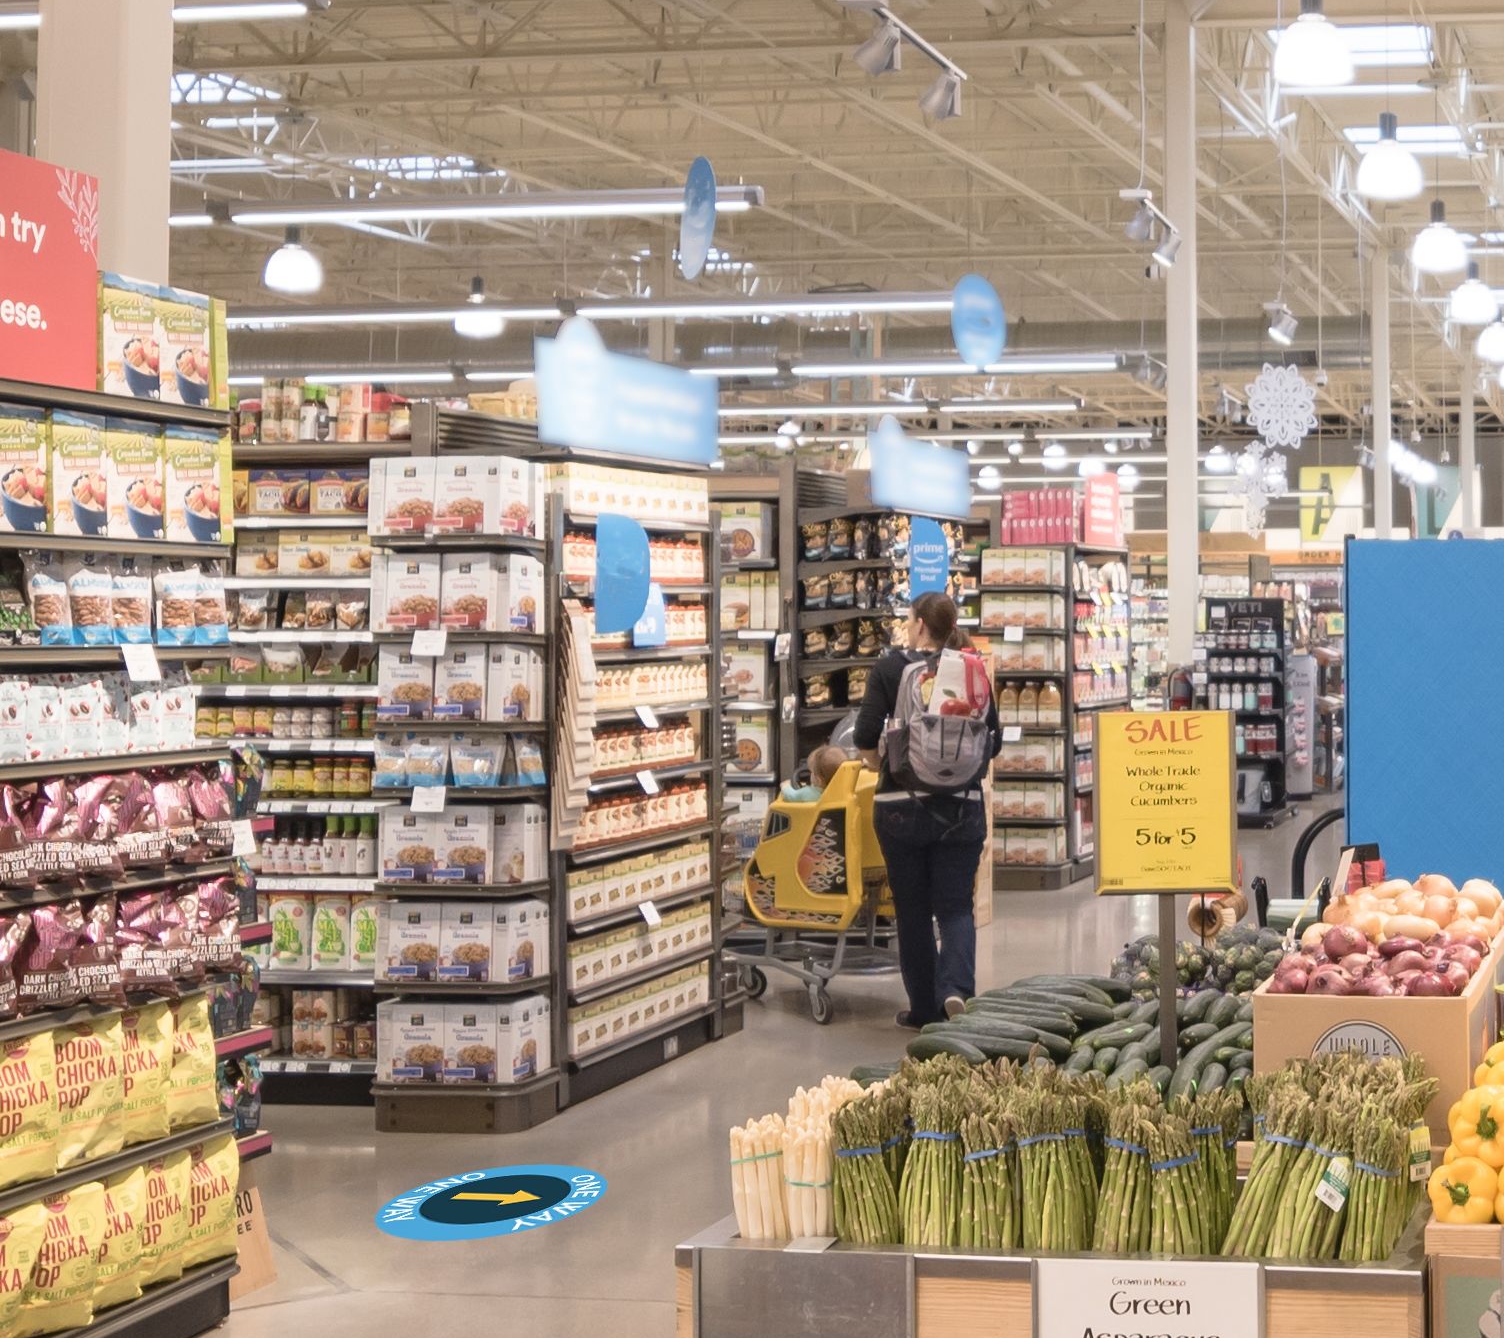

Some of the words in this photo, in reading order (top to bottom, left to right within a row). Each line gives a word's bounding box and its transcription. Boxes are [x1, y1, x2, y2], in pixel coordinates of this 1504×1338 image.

[11, 212, 46, 254] try
[1227, 601, 1263, 613] YETI
[1125, 716, 1203, 743] SALE
[1126, 766, 1163, 777] Whole
[1166, 766, 1200, 776] Trade
[1139, 781, 1188, 794] Organic
[1130, 796, 1198, 806] Cucumbers
[1136, 828, 1151, 846] 5
[1154, 831, 1173, 845] for
[412, 1172, 486, 1195] ONE
[571, 1174, 601, 1198] ONE
[383, 1194, 428, 1224] WAY
[511, 1201, 589, 1231] WAY
[1111, 1276, 1142, 1286] Grown
[1143, 1278, 1152, 1286] in
[1154, 1277, 1186, 1286] Mexico
[1109, 1291, 1191, 1315] Green
